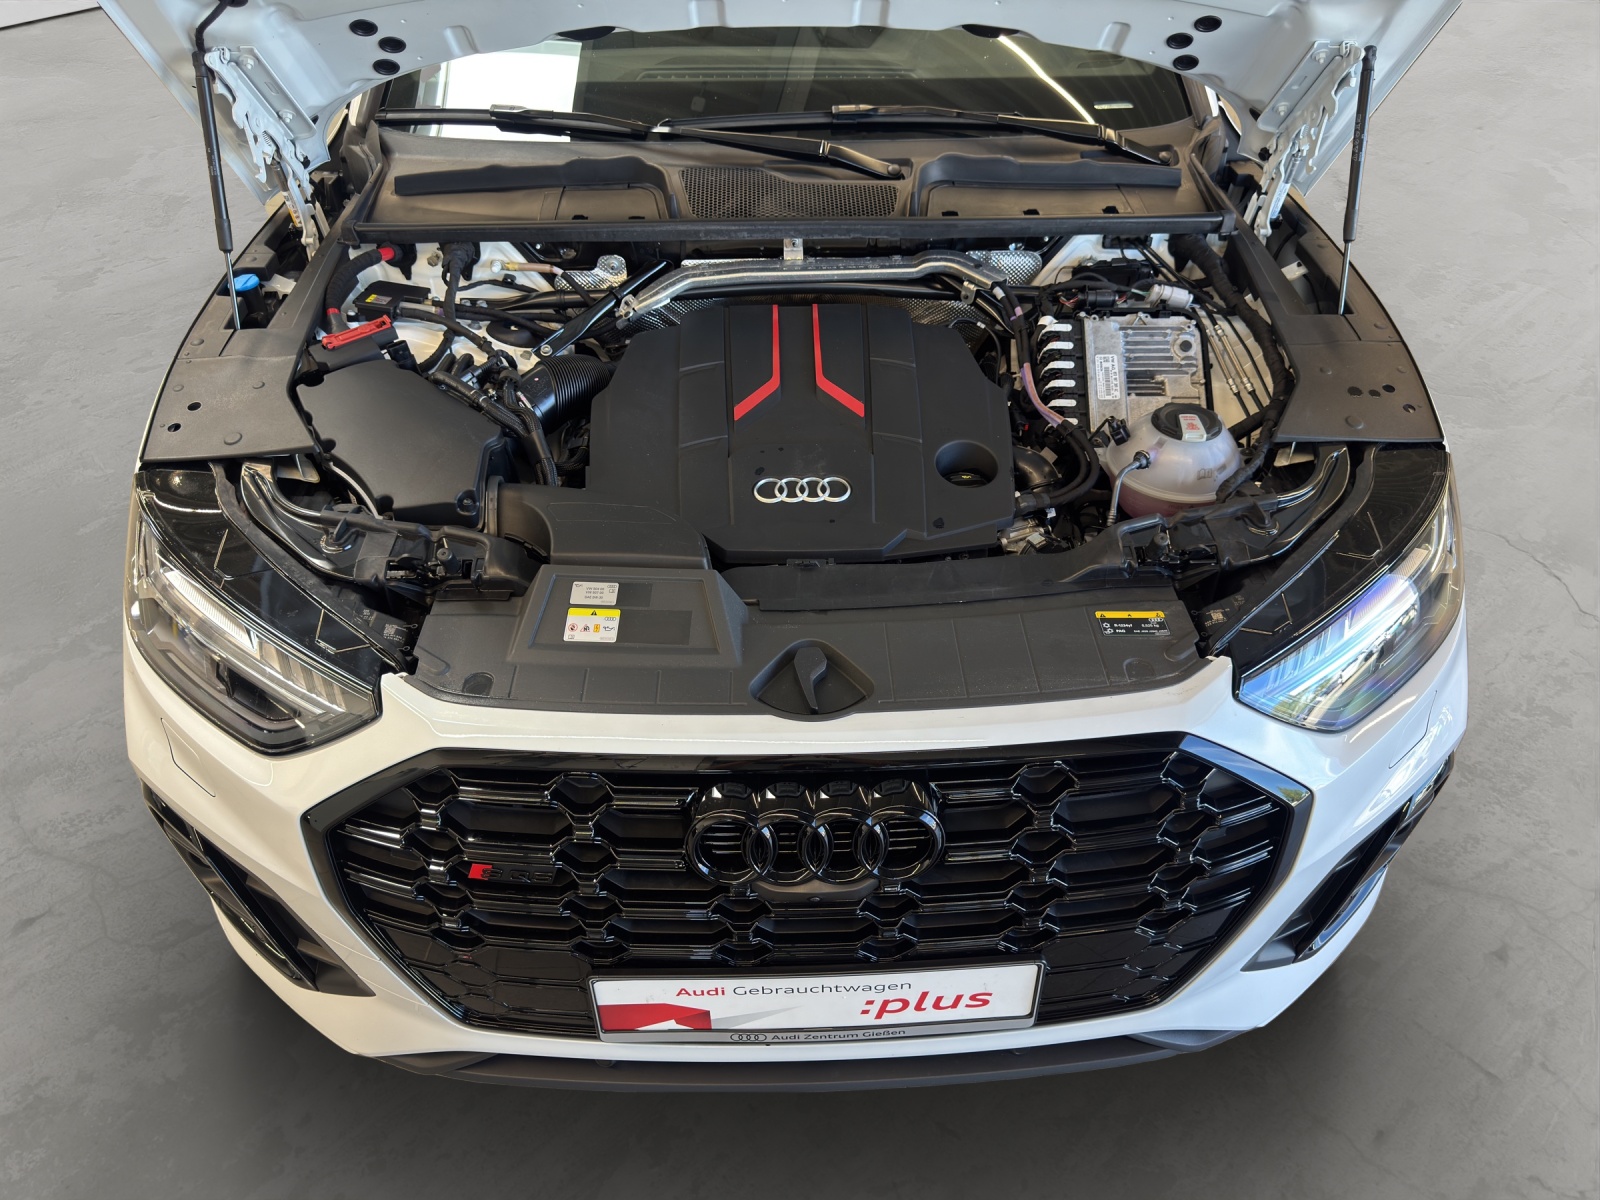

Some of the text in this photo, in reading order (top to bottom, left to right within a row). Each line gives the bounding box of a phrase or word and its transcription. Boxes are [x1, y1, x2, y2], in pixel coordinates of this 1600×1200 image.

[675, 982, 912, 997] Audi Gebrauchtwagen
[860, 991, 993, 1020] :plus
[771, 1028, 906, 1041] Audi Zentrum Gießen
